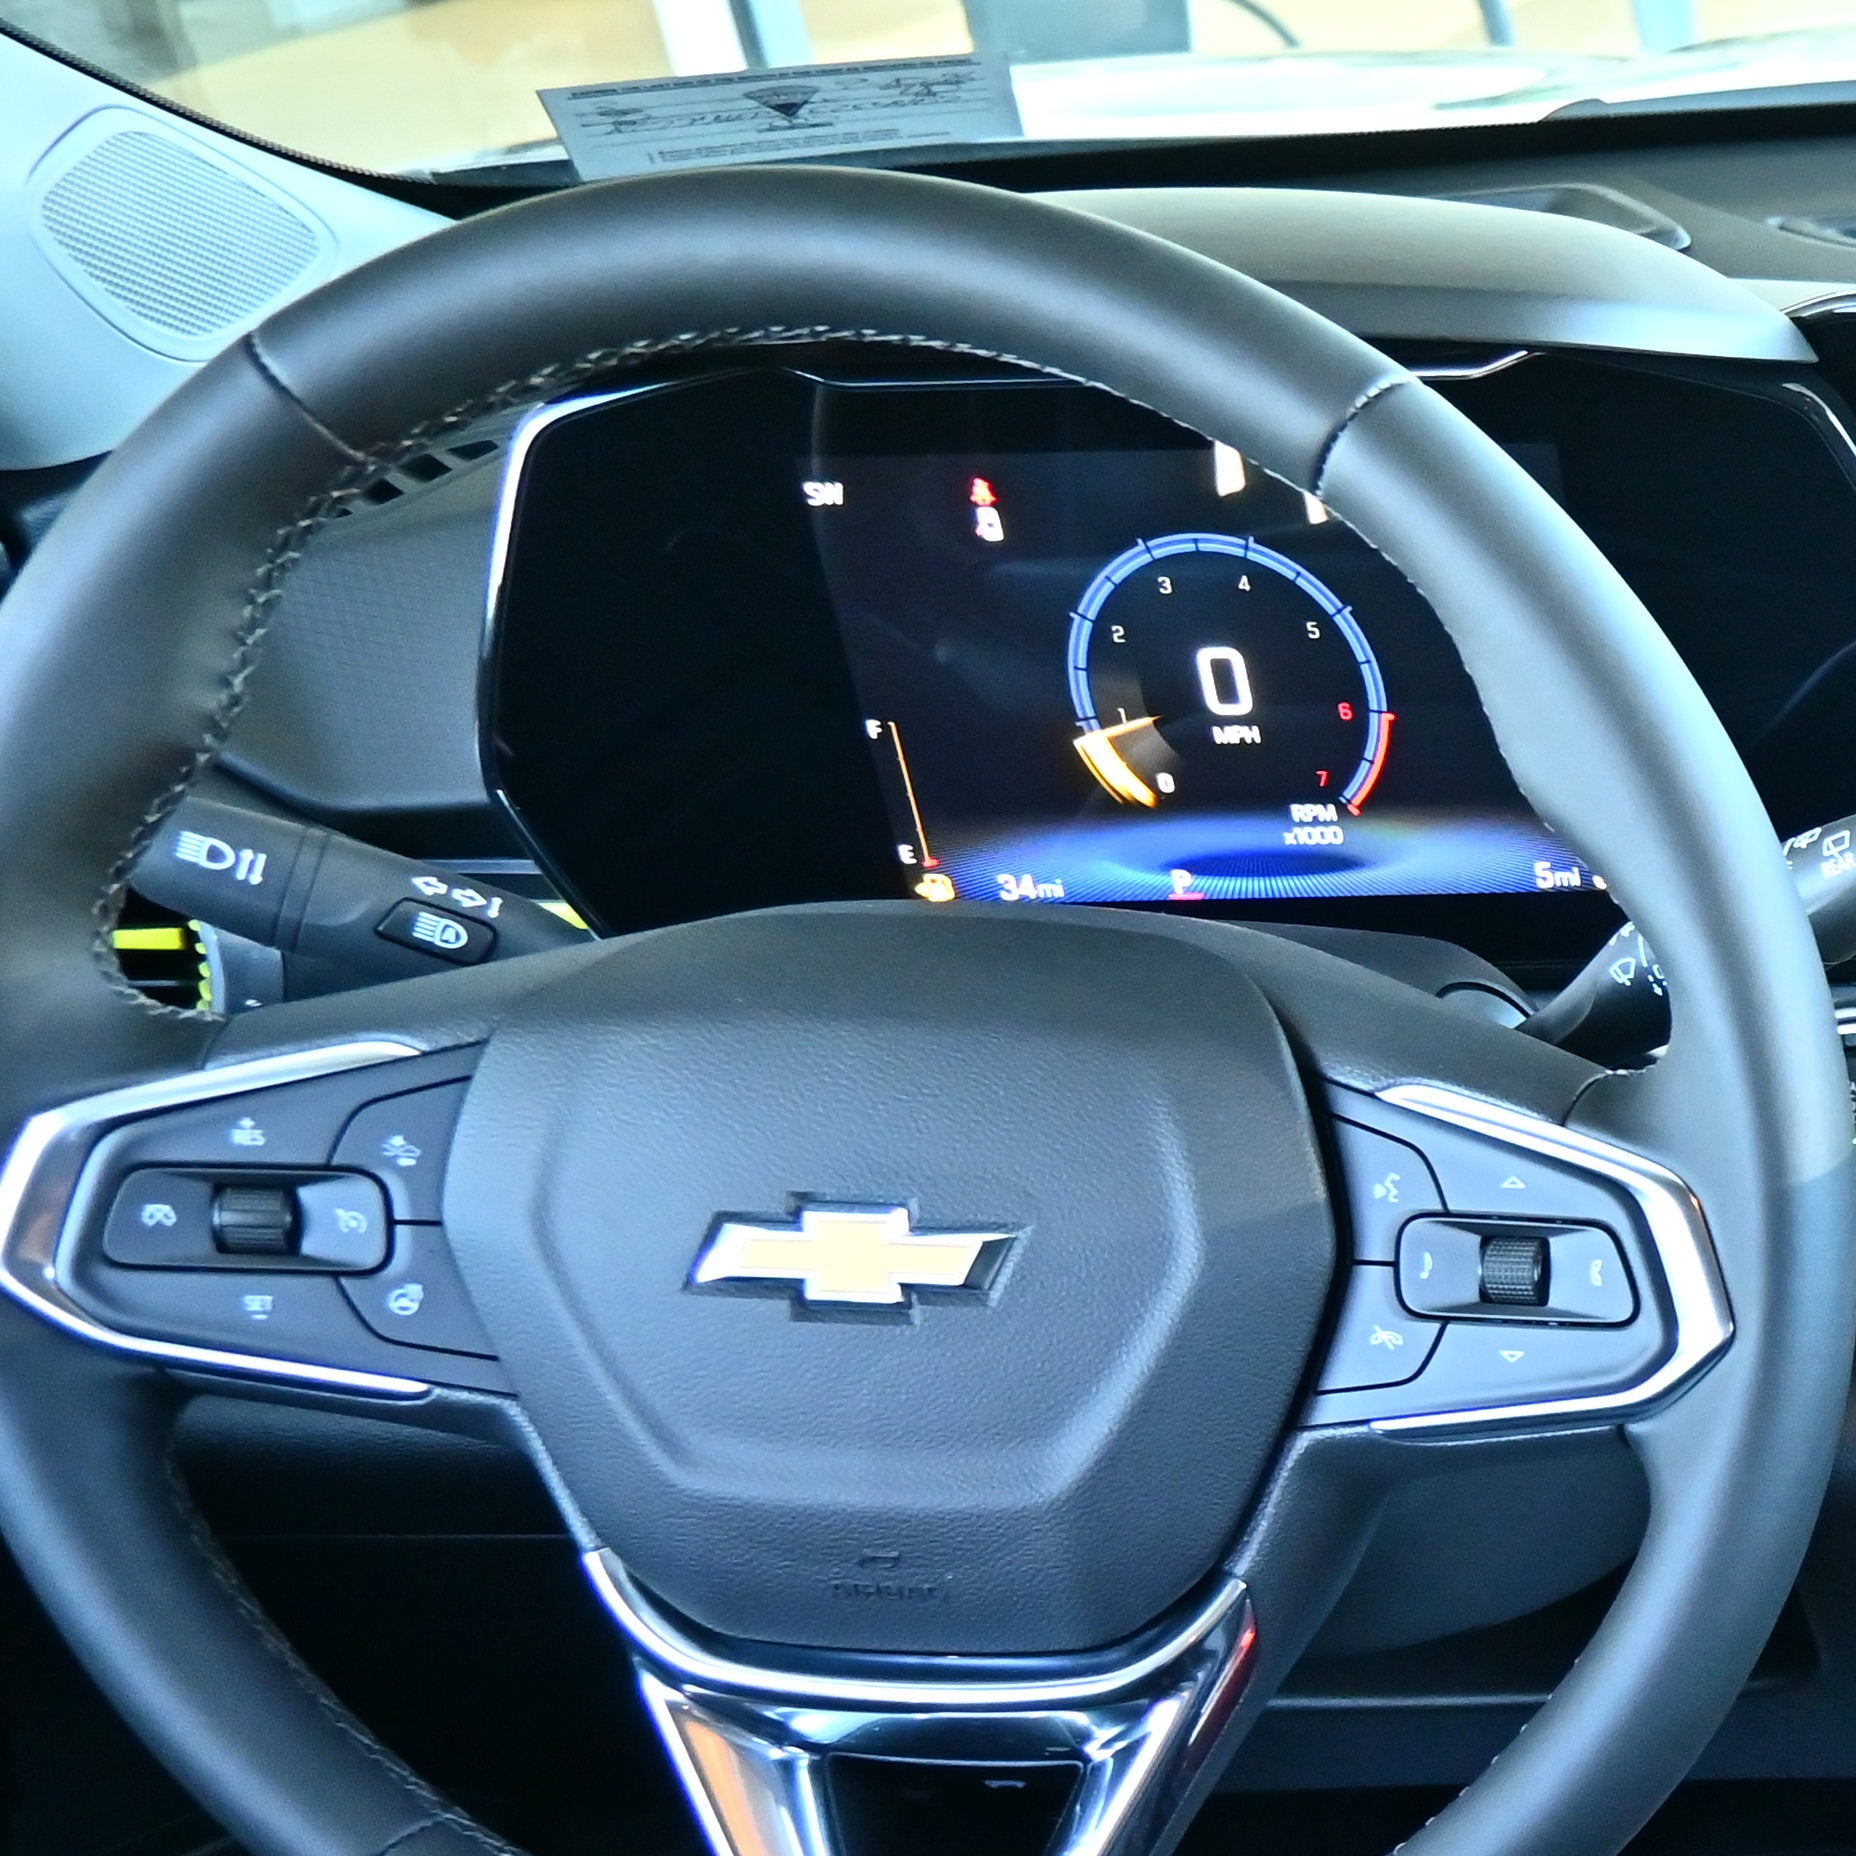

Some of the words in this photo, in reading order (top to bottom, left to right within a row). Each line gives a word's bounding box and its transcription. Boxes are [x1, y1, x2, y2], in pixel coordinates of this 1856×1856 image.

[1157, 576, 1173, 595] 3
[1238, 575, 1251, 592] 4
[1111, 625, 1126, 643] 2
[1306, 621, 1320, 640] 5
[1196, 646, 1252, 716] 0
[1117, 707, 1127, 724] 1
[1337, 702, 1354, 722] 6
[865, 718, 882, 740] F
[1212, 725, 1262, 744] MPH
[1156, 772, 1176, 794] 0
[1315, 770, 1329, 787] 7
[1289, 803, 1338, 822] RPM
[1283, 826, 1345, 846] x1000
[897, 844, 917, 864] E
[1170, 869, 1193, 895] P
[1534, 861, 1581, 889] 5mi
[996, 873, 1065, 901] 34mi
